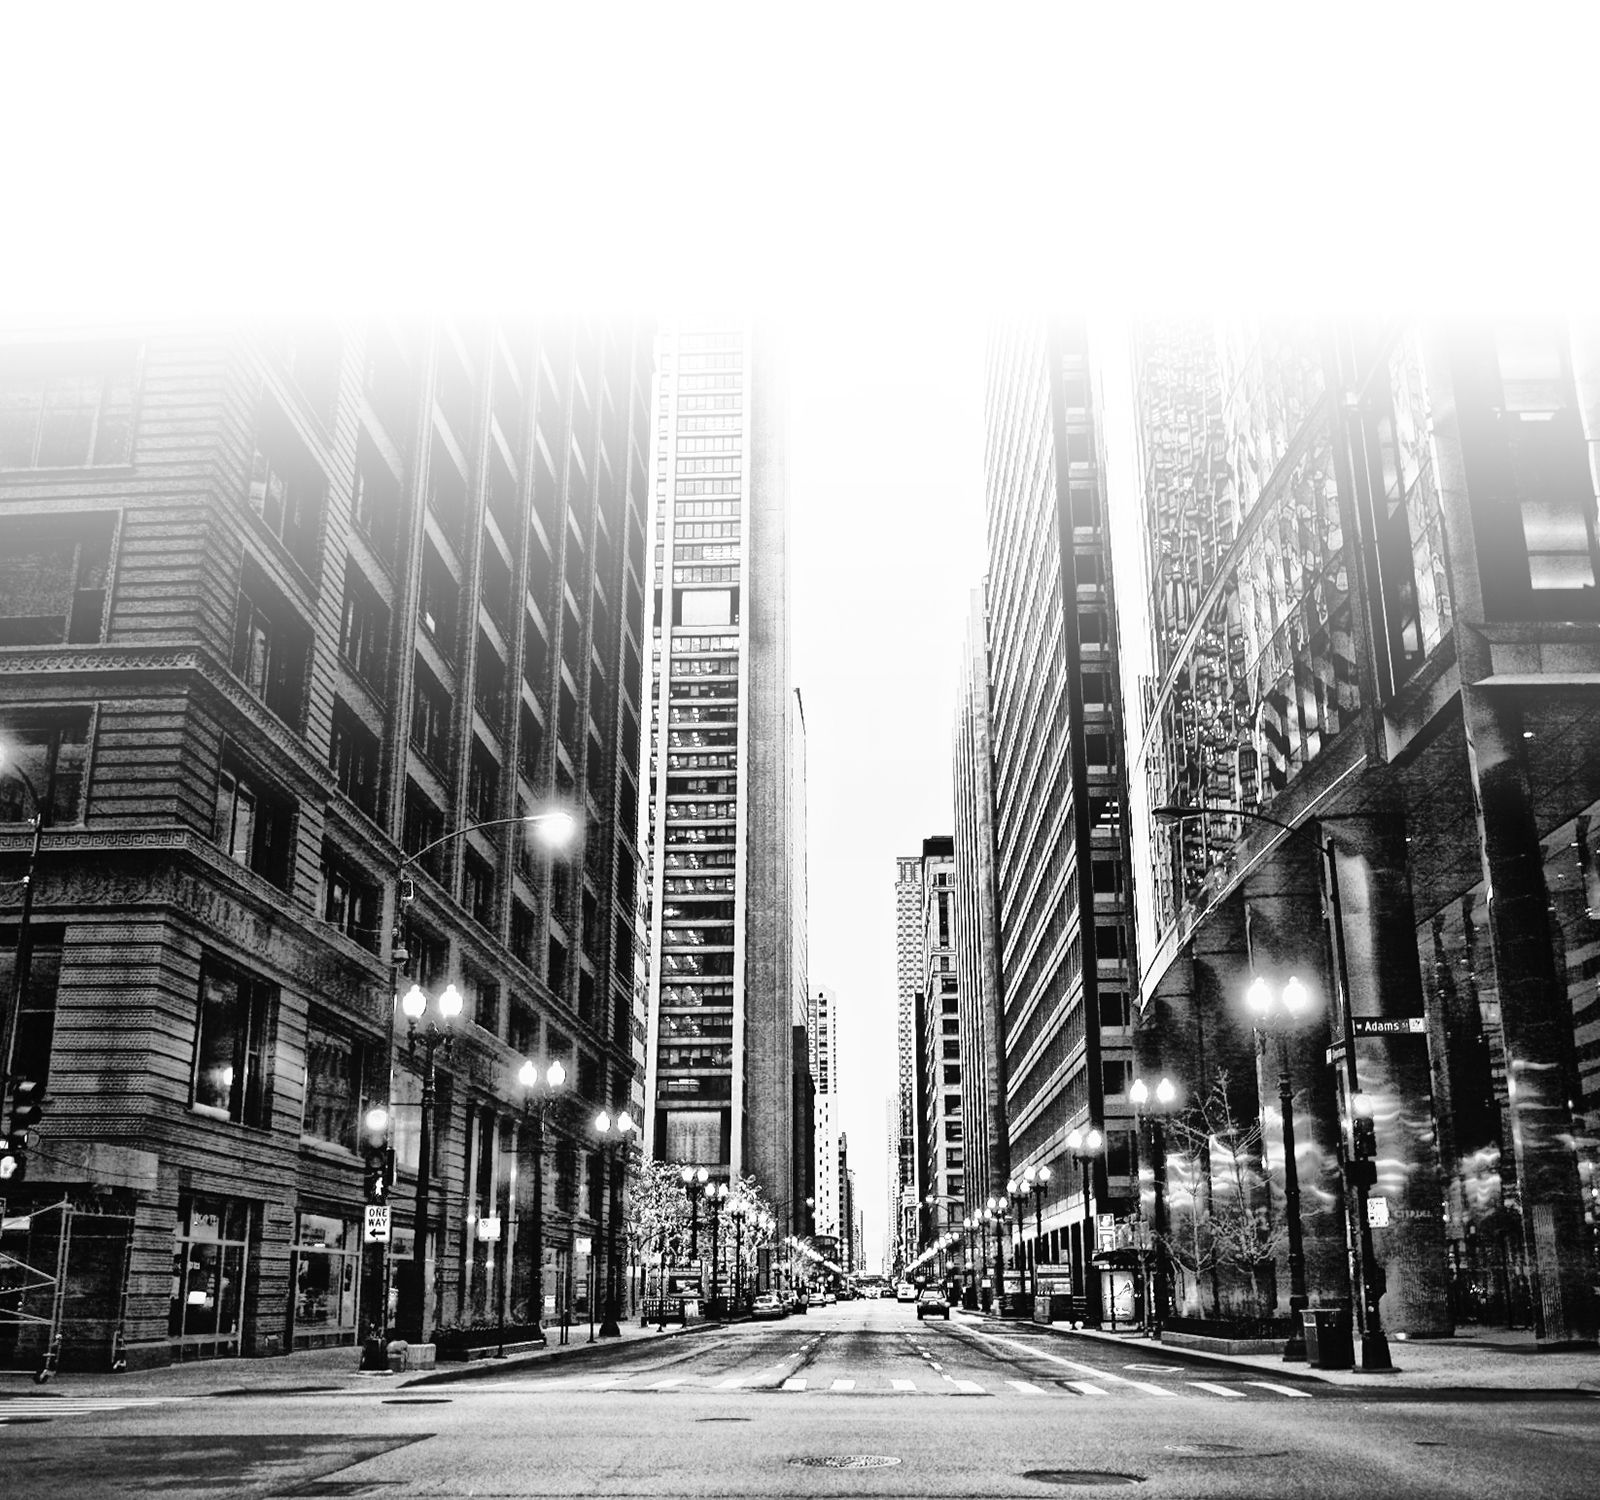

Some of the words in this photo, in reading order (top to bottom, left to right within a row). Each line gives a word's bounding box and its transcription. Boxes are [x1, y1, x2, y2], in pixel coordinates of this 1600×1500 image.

[1365, 1021, 1399, 1031] Adams
[369, 1208, 387, 1217] ONE
[368, 1218, 387, 1226] WAY
